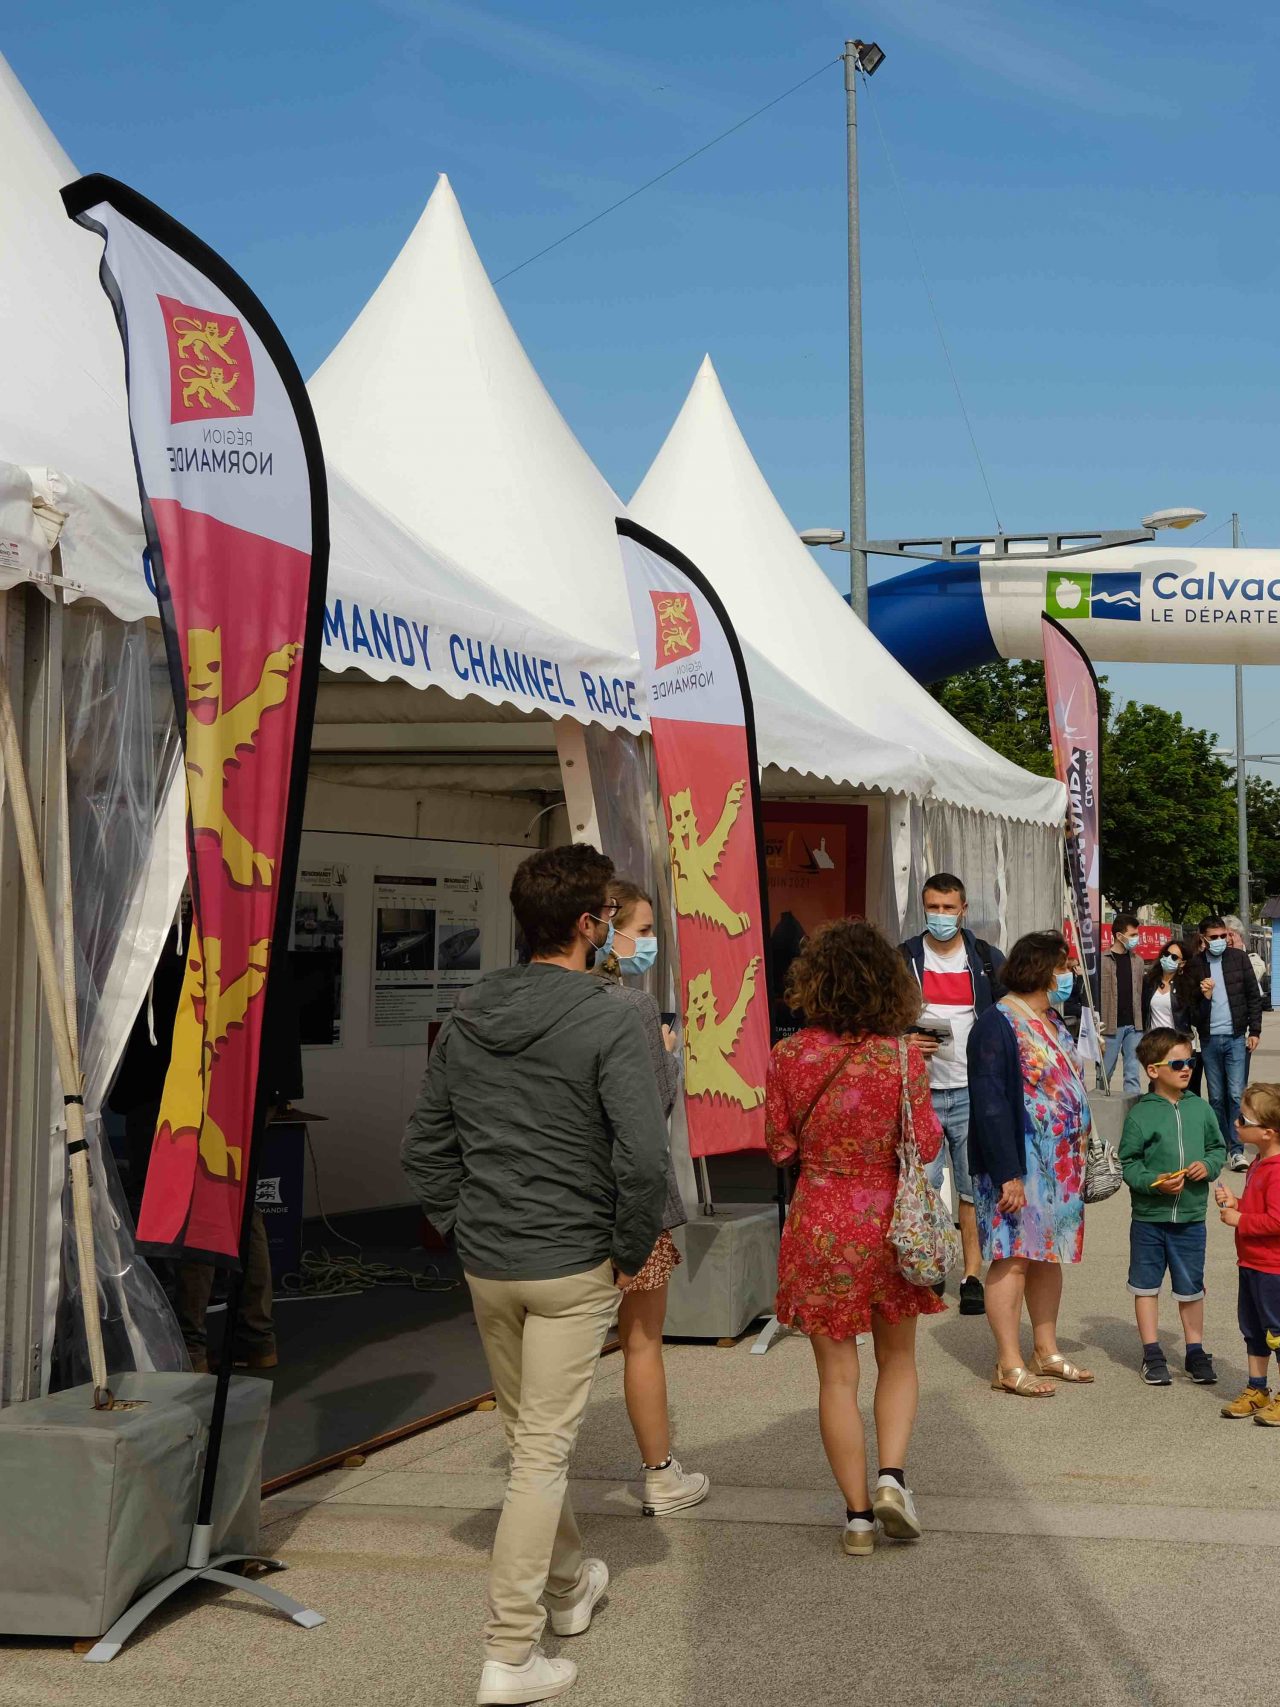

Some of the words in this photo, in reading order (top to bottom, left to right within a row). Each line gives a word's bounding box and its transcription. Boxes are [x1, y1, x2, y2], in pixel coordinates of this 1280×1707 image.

[1151, 608, 1174, 623] LE
[449, 633, 576, 707] CHANNEL
[580, 670, 642, 721] RACE
